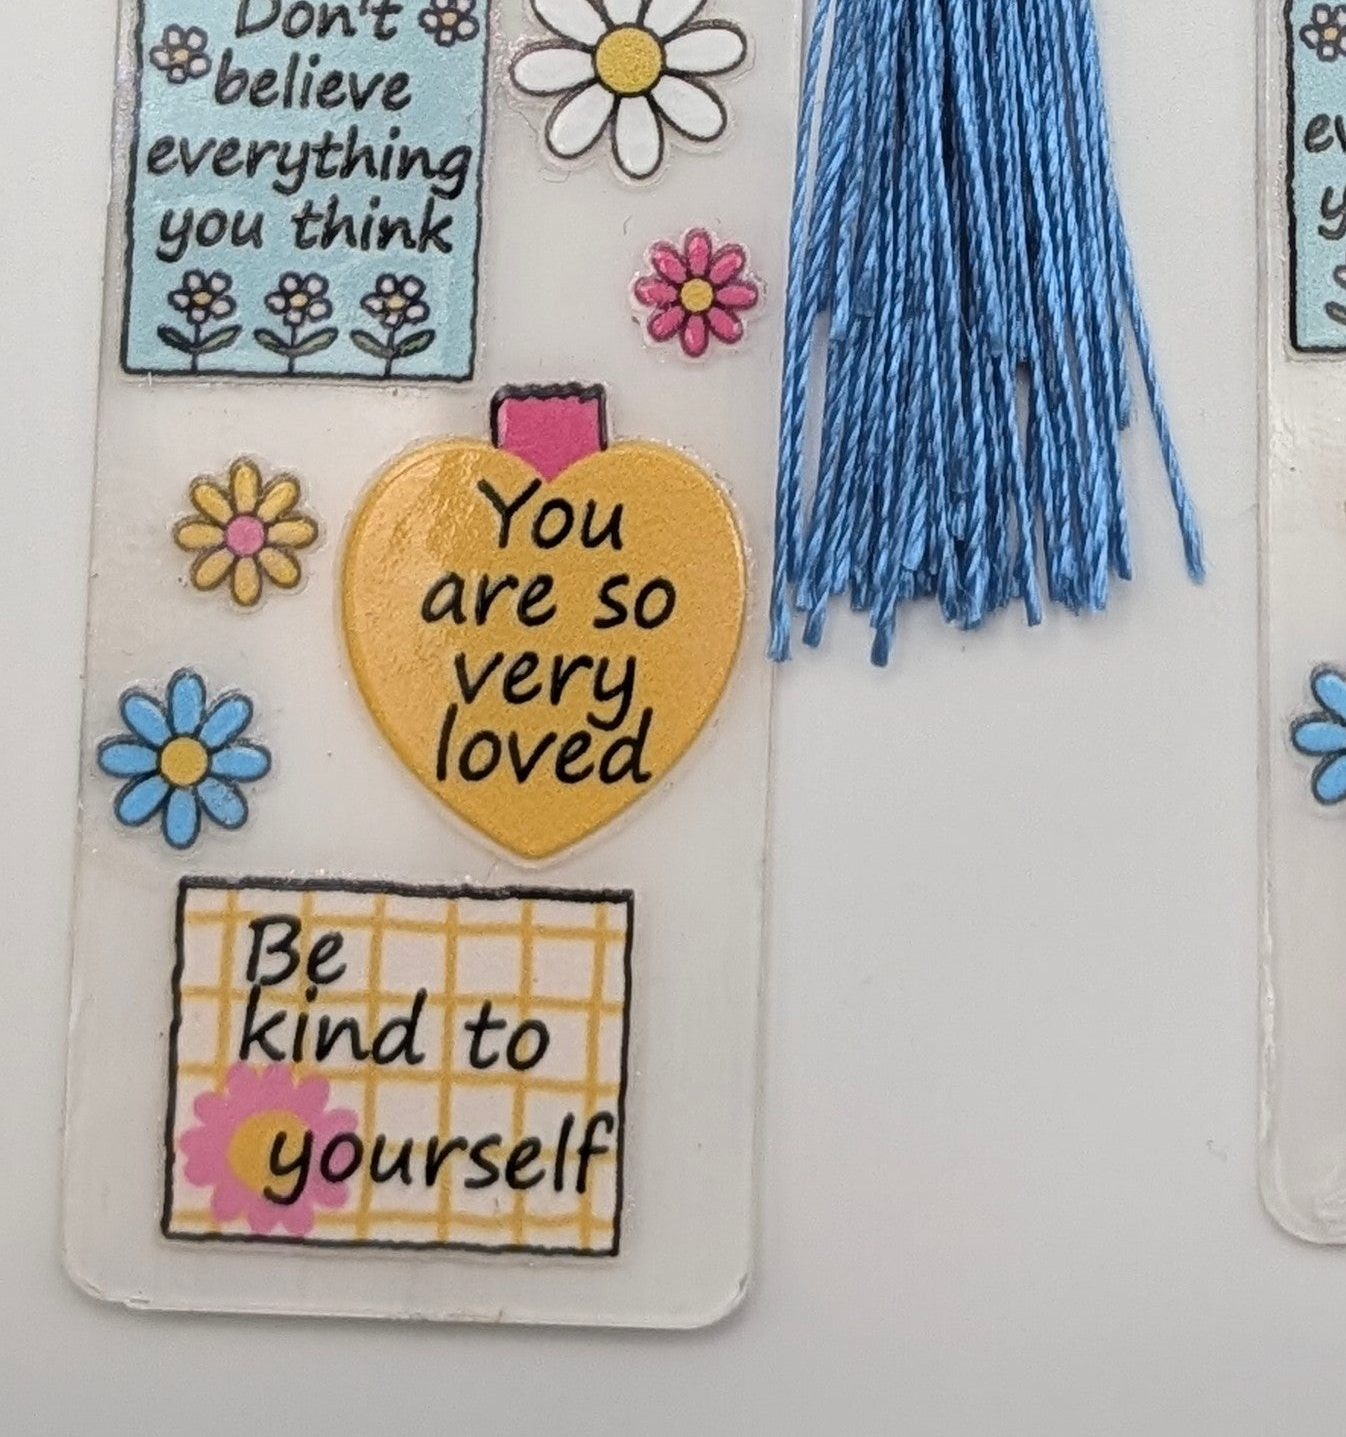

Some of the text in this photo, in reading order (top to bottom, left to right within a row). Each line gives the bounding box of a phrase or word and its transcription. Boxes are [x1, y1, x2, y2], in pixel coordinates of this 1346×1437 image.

[213, 50, 411, 110] believe
[146, 129, 471, 201] everything
[158, 198, 454, 262] you think
[477, 478, 625, 551] You
[421, 575, 677, 629] are so
[453, 651, 638, 731] very
[437, 707, 652, 786] loved
[245, 914, 348, 986] Be
[240, 982, 548, 1072] kind to
[264, 1111, 616, 1207] yourself
